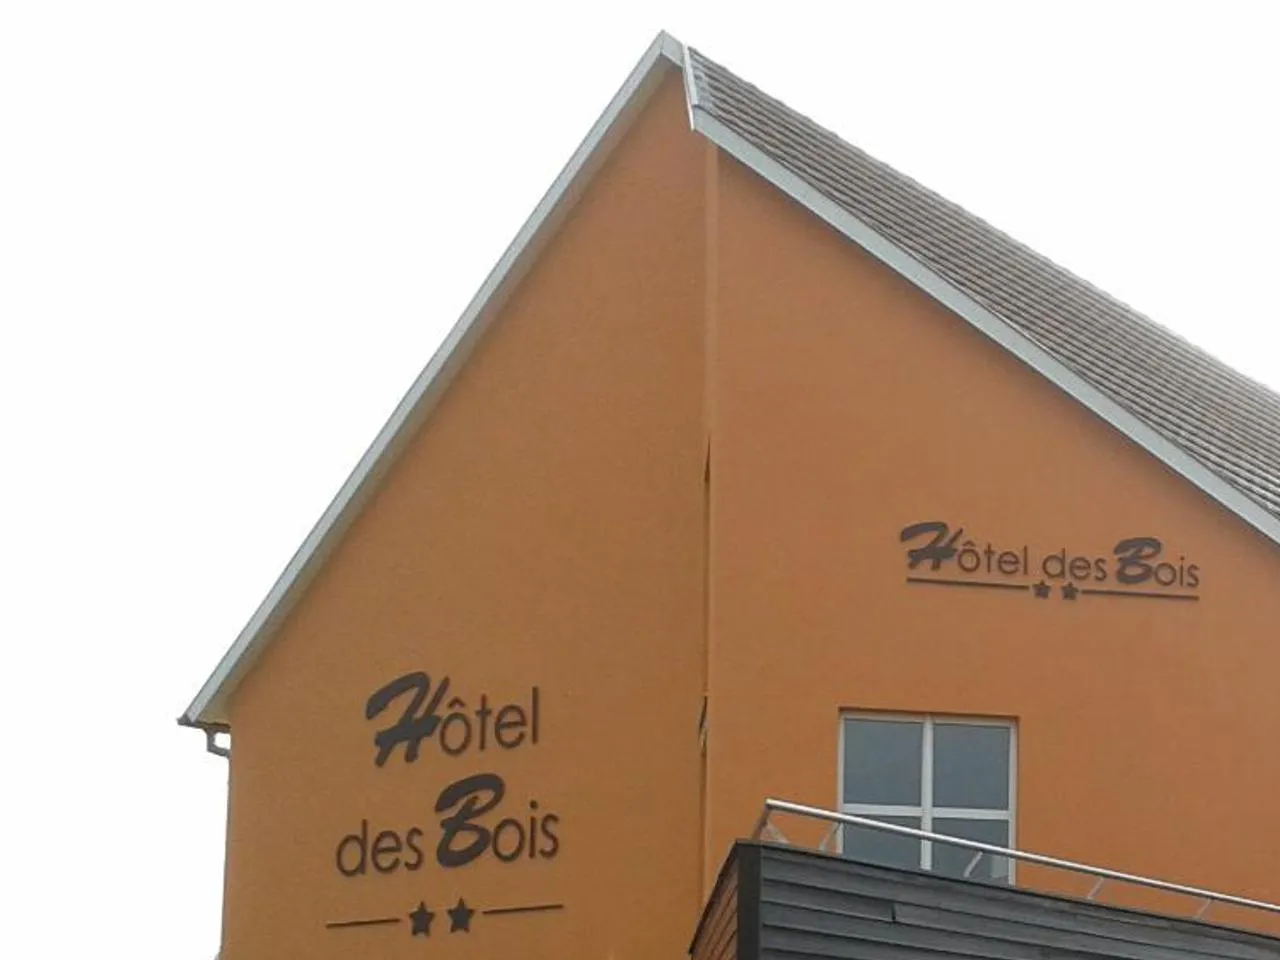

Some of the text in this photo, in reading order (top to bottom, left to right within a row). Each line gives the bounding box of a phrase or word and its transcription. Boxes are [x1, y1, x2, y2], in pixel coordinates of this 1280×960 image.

[900, 521, 1201, 588] Hôtel des Bois
[365, 671, 540, 768] Hôtel
[336, 773, 560, 878] des Bois
